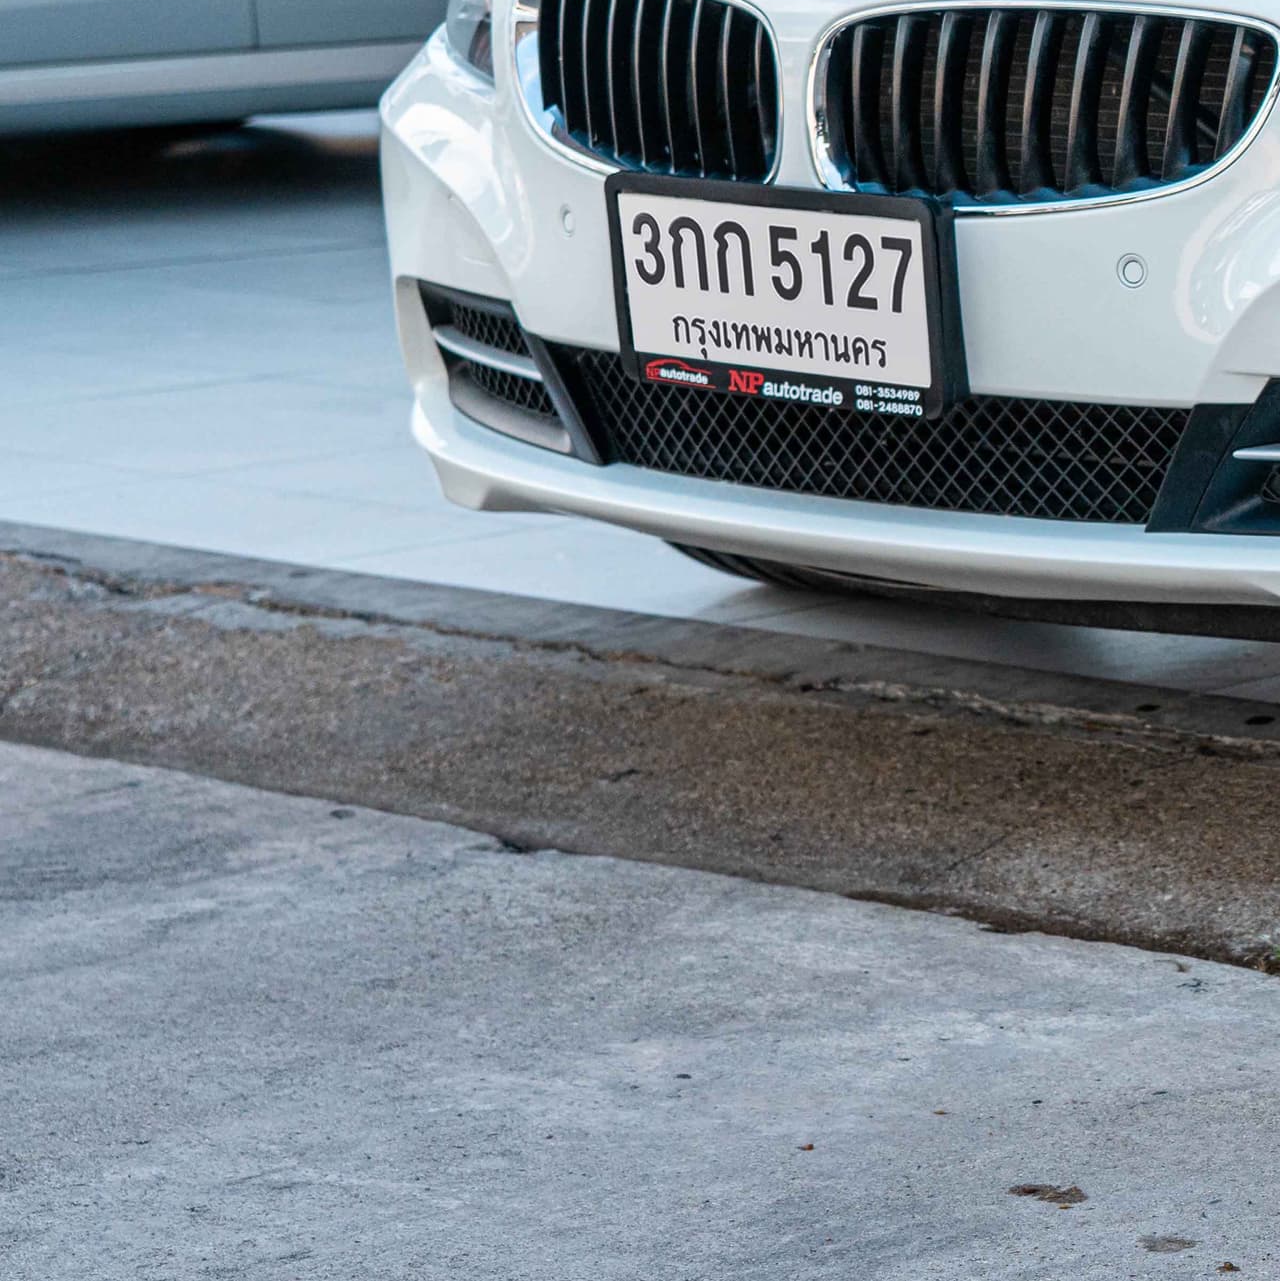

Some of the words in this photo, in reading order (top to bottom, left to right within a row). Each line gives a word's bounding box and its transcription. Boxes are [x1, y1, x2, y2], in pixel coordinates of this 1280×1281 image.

[632, 212, 755, 297] 3กก
[769, 224, 913, 313] 5127
[672, 315, 887, 368] กรุงเทพมหานคร
[855, 384, 920, 402] 081-3534989
